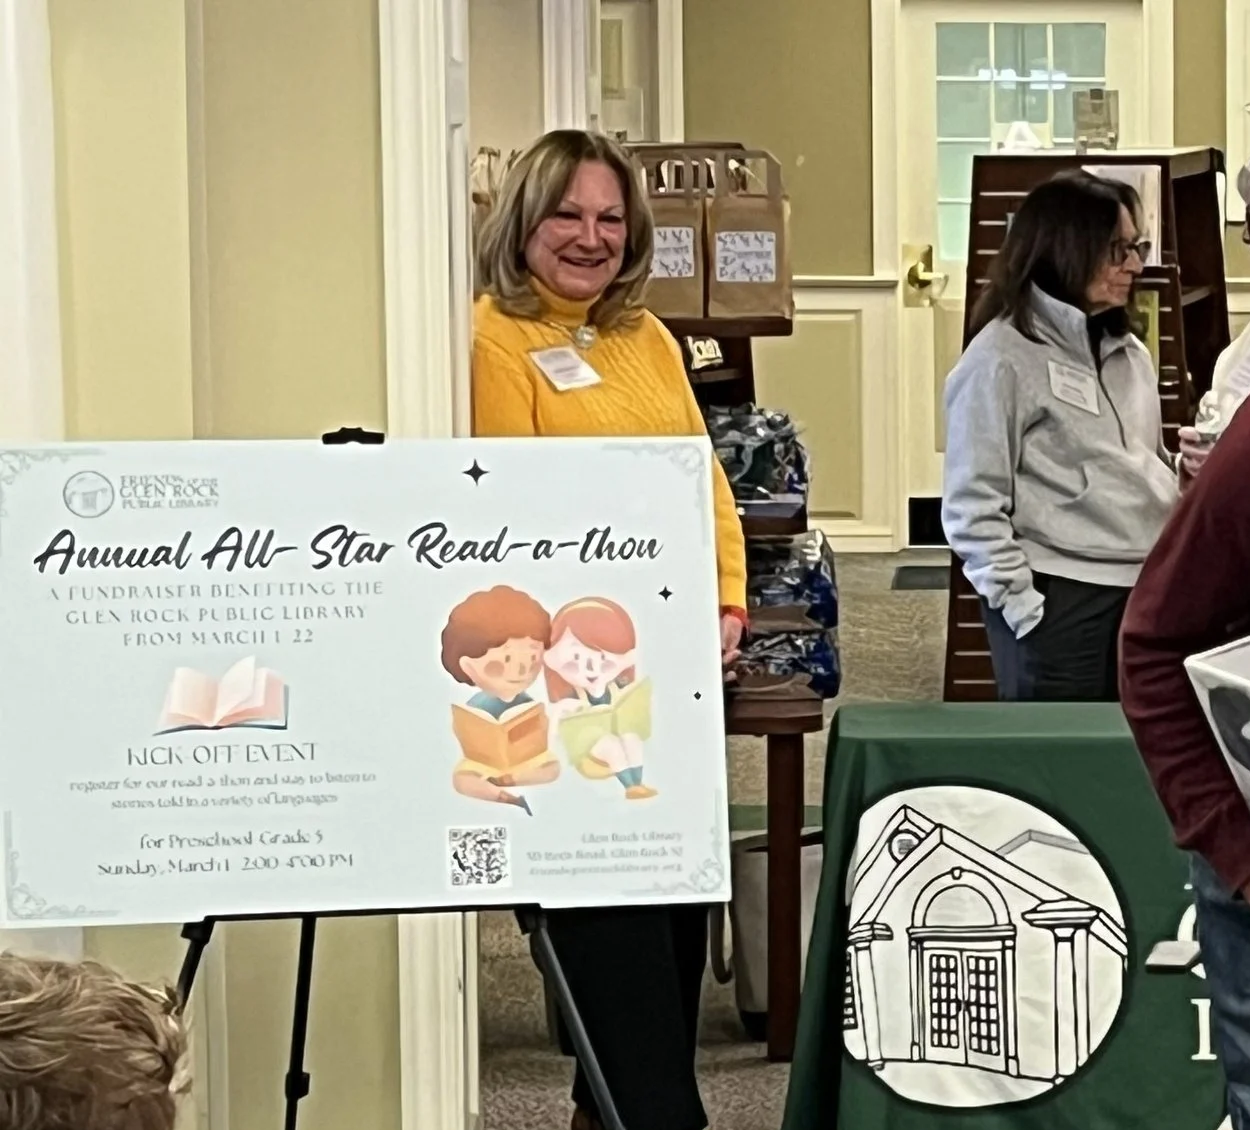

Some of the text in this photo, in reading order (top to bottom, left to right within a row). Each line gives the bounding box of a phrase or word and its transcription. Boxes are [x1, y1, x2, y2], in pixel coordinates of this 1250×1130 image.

[119, 483, 220, 499] GLEN ROCK
[33, 528, 193, 575] Annual
[310, 524, 396, 570] Star
[407, 521, 665, 570] Read-a-thon
[68, 583, 201, 601] FUNDRAISER
[210, 581, 336, 599] BENEFITING
[344, 580, 384, 596] THE
[65, 605, 367, 625] GLEN ROCK PUBLIC LIBRARY
[122, 631, 182, 647] FROM
[191, 630, 266, 646] MARCH
[246, 742, 317, 763] EVENT
[122, 777, 142, 790] for
[146, 779, 168, 789] our
[253, 773, 278, 786] and
[309, 774, 323, 785] to
[157, 796, 183, 808] told
[140, 833, 162, 849] for
[329, 853, 353, 868] PM
